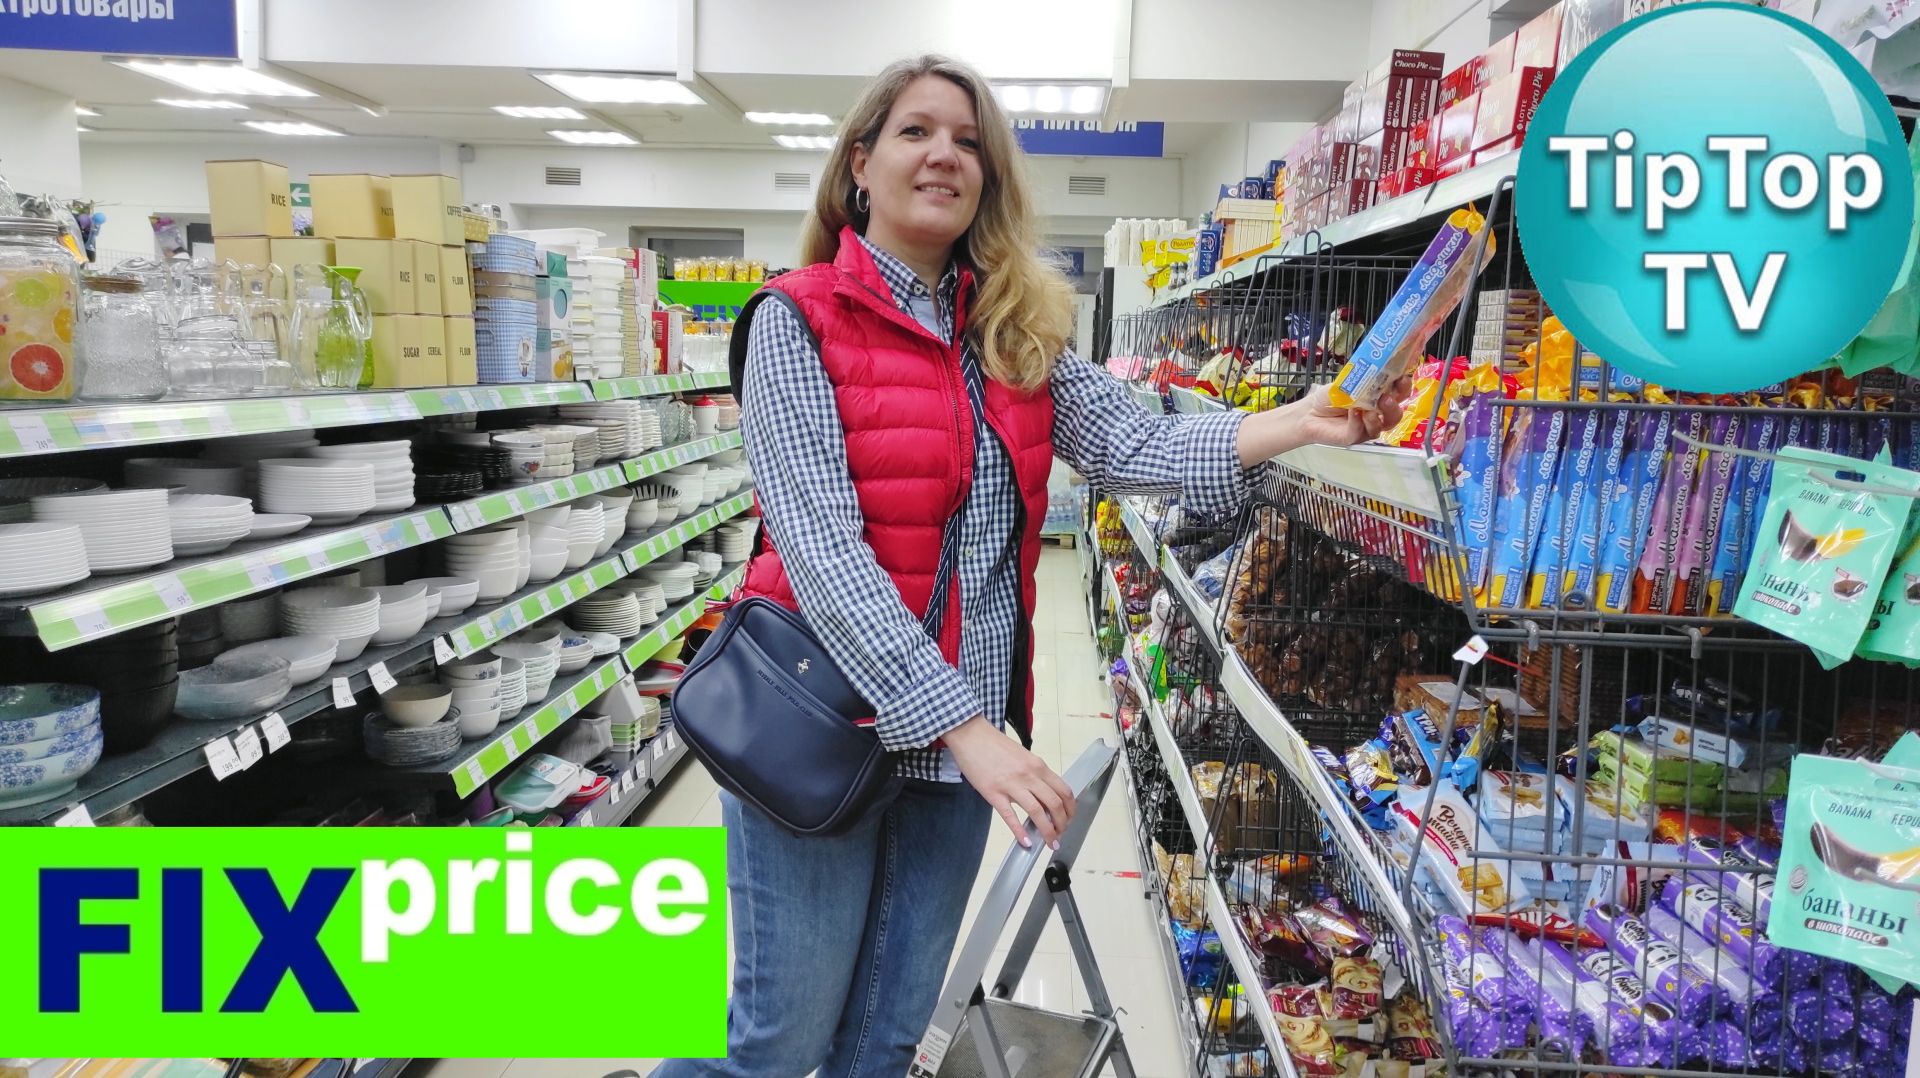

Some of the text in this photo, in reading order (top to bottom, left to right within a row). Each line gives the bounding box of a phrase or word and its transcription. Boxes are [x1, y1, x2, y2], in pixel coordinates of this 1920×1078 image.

[1395, 60, 1416, 68] Choco
[1416, 61, 1429, 70] Pie
[1534, 70, 1544, 88] Pie
[1519, 99, 1527, 123] LOTTE
[271, 193, 287, 207] RICE
[447, 205, 463, 217] COFFEE
[424, 272, 436, 284] PASTA
[452, 275, 464, 285] FLOUR
[1369, 230, 1464, 360] Мамины ладошки
[403, 346, 420, 358] SUGAR
[427, 346, 442, 356] CEREAL
[459, 346, 471, 356] FLOUR
[1539, 410, 1564, 480] ладошки
[1576, 409, 1599, 477] ладошки
[1606, 409, 1629, 475] ладошки
[1647, 410, 1670, 478] ладошки
[1798, 489, 1829, 506] BANANA
[1828, 802, 1873, 820] BANANA
[1427, 817, 1460, 851] тайна
[1802, 888, 1909, 935] бананы
[1815, 920, 1882, 946] шоколаде
